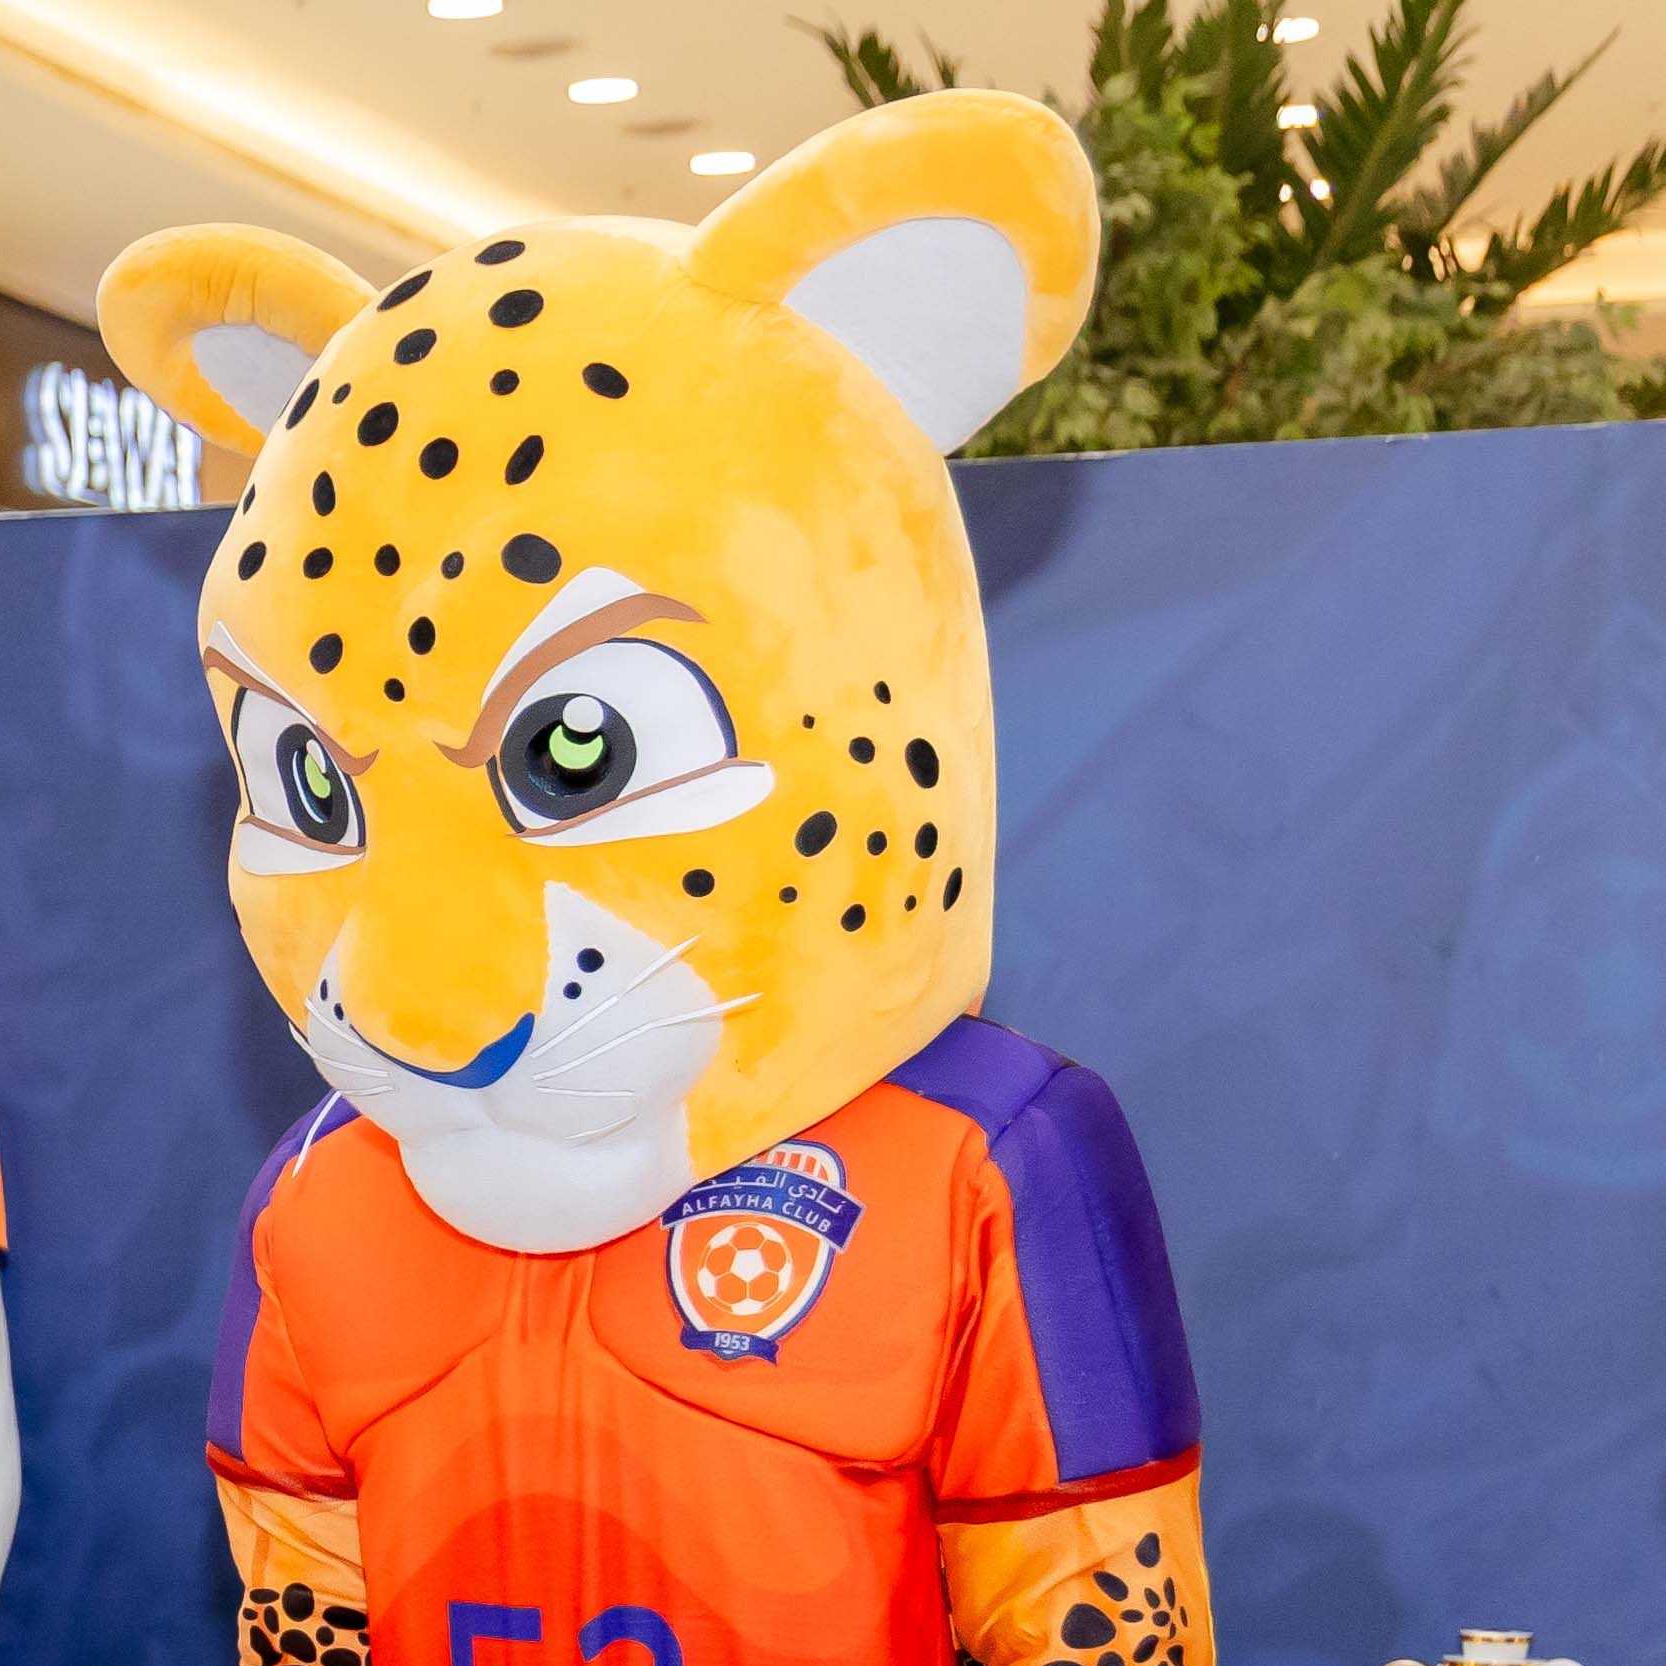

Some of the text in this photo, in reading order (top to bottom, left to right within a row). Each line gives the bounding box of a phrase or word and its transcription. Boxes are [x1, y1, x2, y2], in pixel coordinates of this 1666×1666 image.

[682, 1194, 832, 1233] ALFAYHA CLUB
[715, 1332, 750, 1351] 1953
